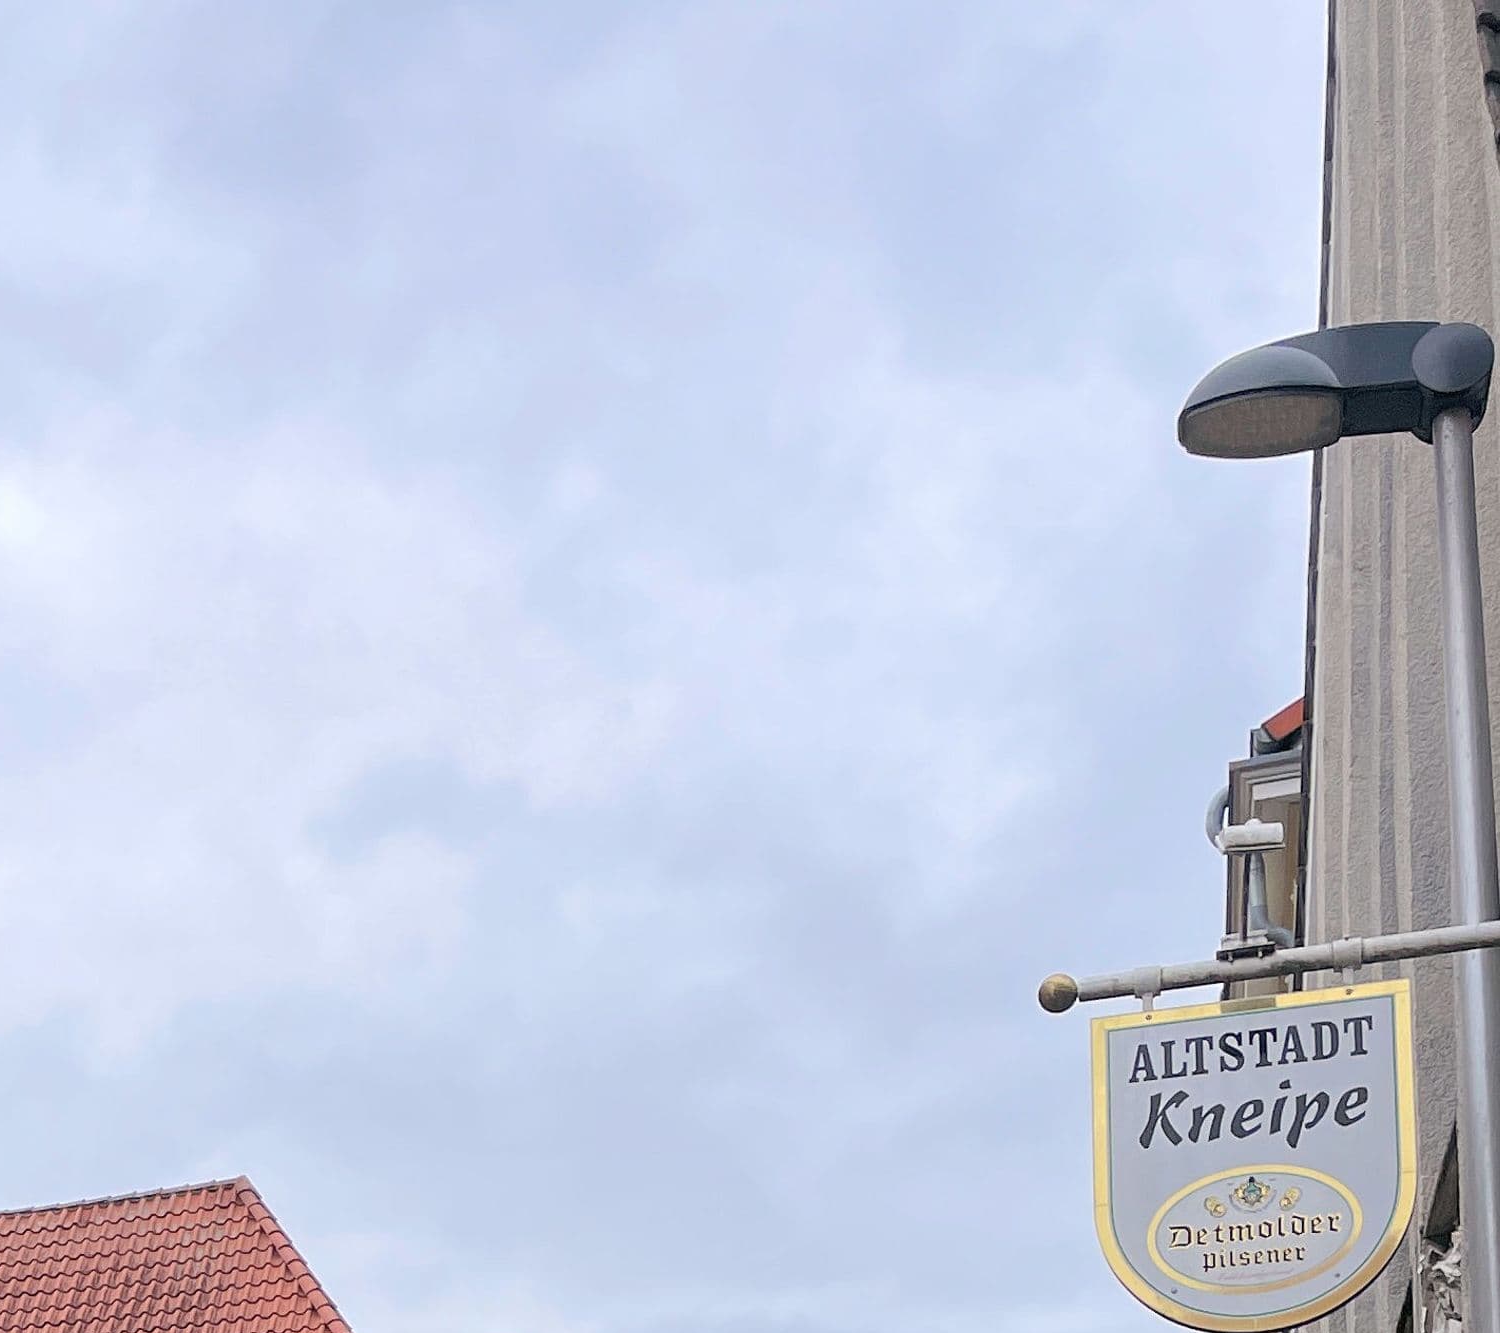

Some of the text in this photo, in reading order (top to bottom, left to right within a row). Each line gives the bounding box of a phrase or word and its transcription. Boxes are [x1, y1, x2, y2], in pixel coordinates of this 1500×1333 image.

[1128, 1015, 1373, 1084] ALTSTADT
[1138, 1079, 1369, 1149] Kneipe
[1168, 1214, 1342, 1248] Detmolder
